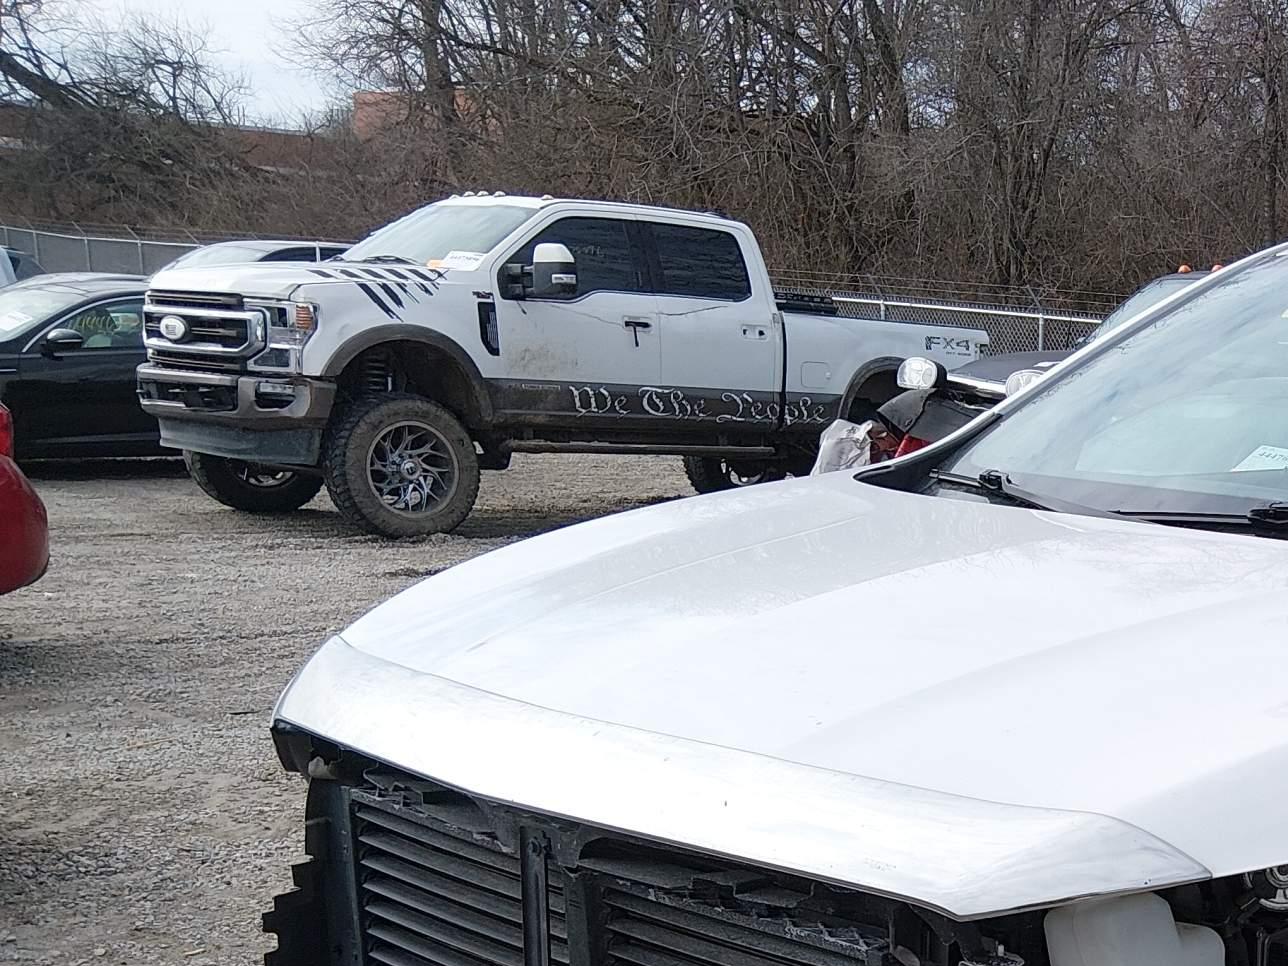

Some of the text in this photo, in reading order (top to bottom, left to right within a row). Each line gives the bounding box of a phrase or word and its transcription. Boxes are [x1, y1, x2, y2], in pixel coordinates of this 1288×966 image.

[925, 336, 969, 351] FX4
[568, 385, 831, 426] We The People
